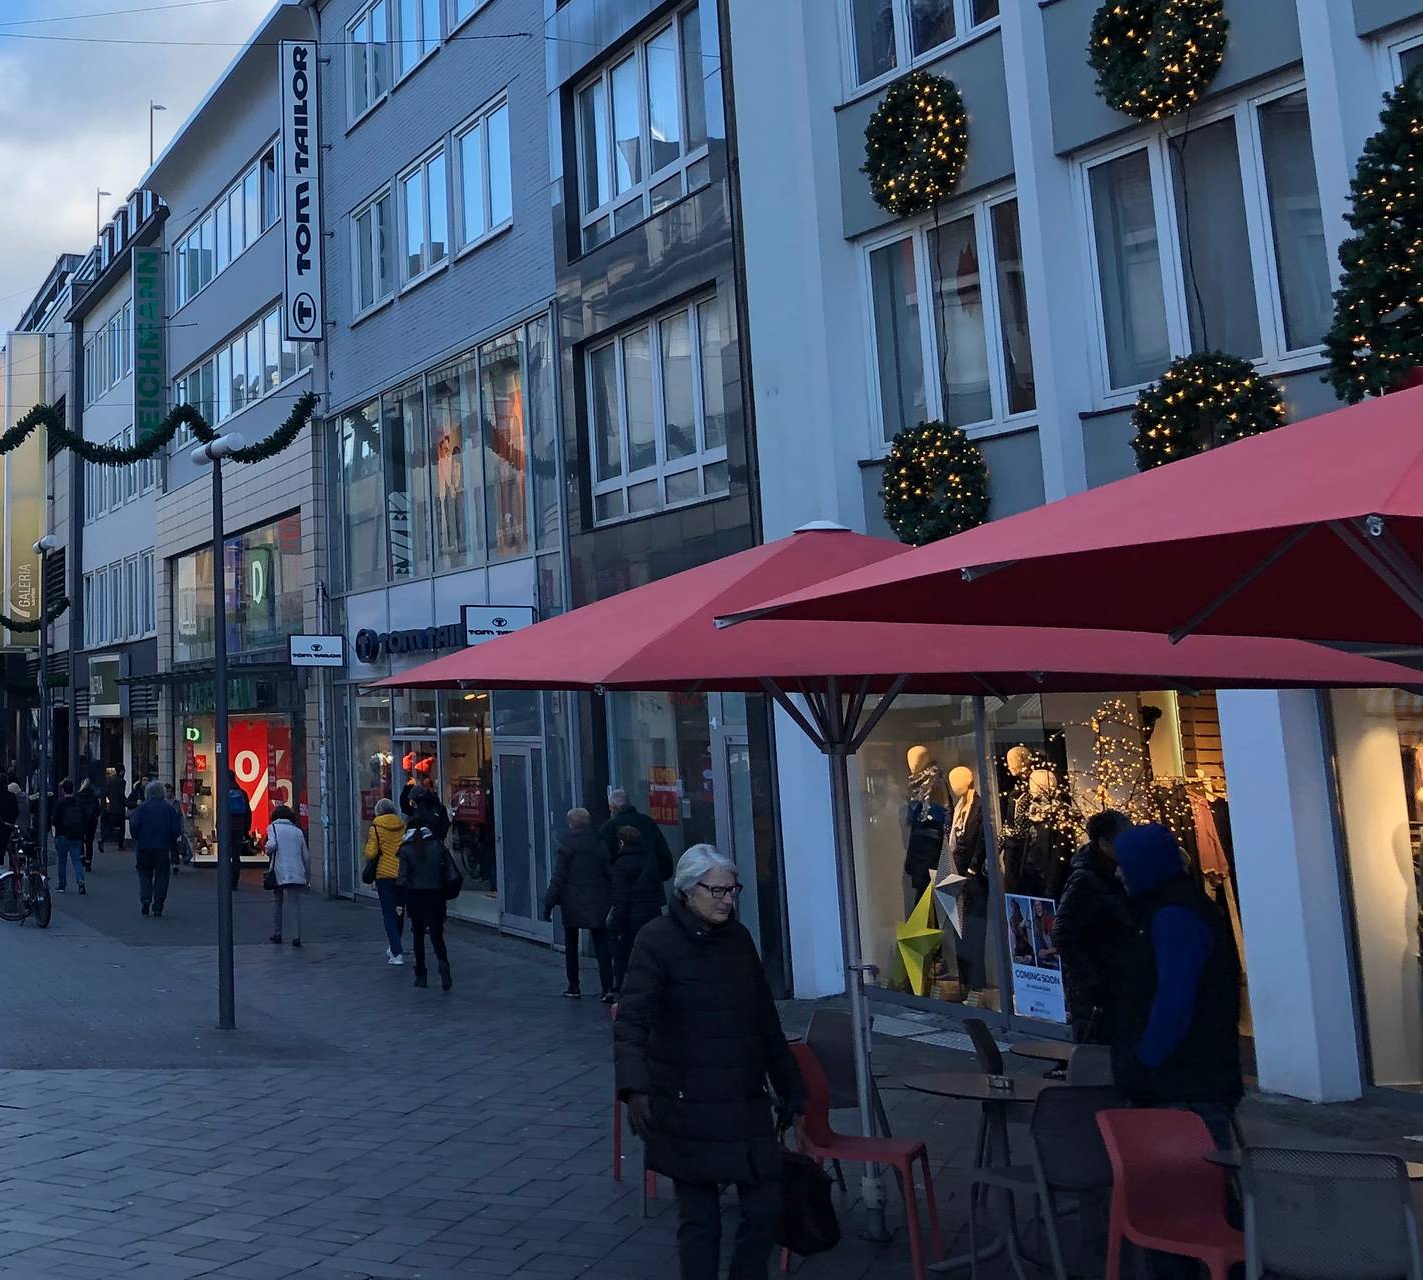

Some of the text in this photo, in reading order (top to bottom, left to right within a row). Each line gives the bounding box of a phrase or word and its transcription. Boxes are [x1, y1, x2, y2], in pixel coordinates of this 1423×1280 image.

[292, 45, 312, 276] TOM TAILOR
[18, 563, 31, 608] GALERIA
[186, 727, 200, 741] D
[1015, 969, 1060, 985] COMING SOON
